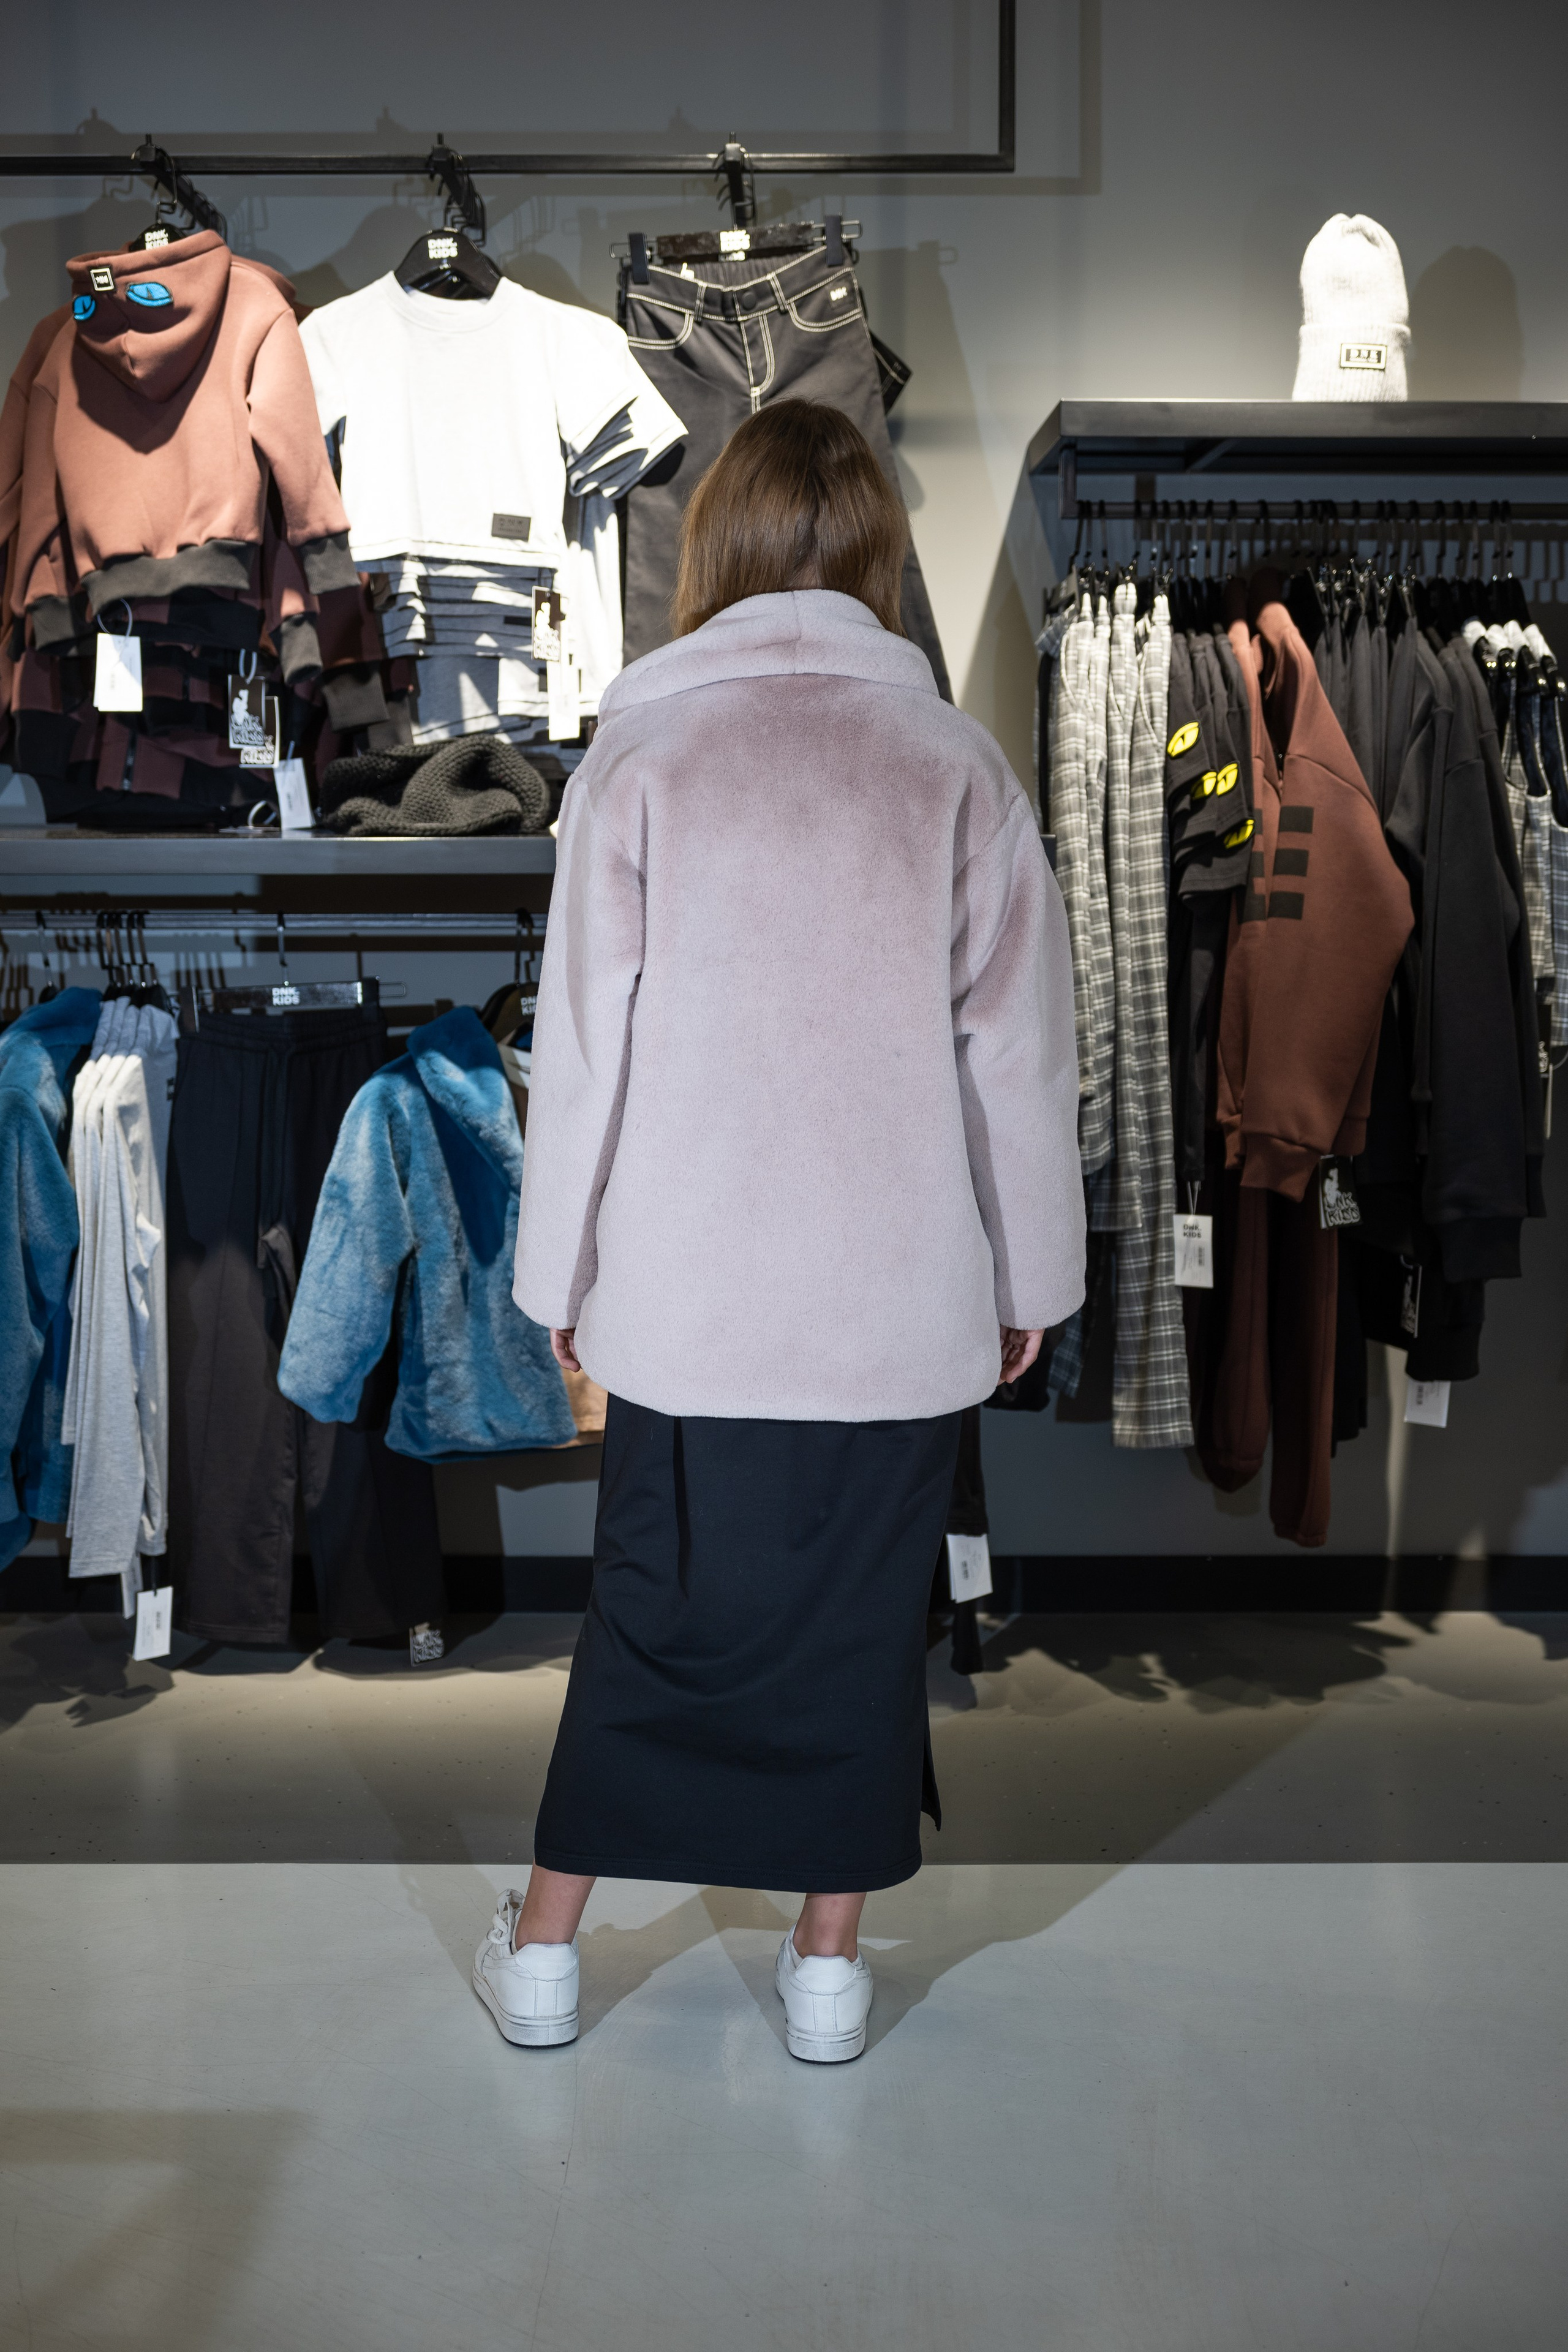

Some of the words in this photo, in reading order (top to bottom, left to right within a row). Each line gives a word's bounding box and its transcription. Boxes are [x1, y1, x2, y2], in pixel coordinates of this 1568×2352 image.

[428, 237, 458, 249] DNK.
[429, 247, 458, 259] KIDS
[271, 987, 300, 997] DNK.
[273, 995, 300, 1006] KIDS
